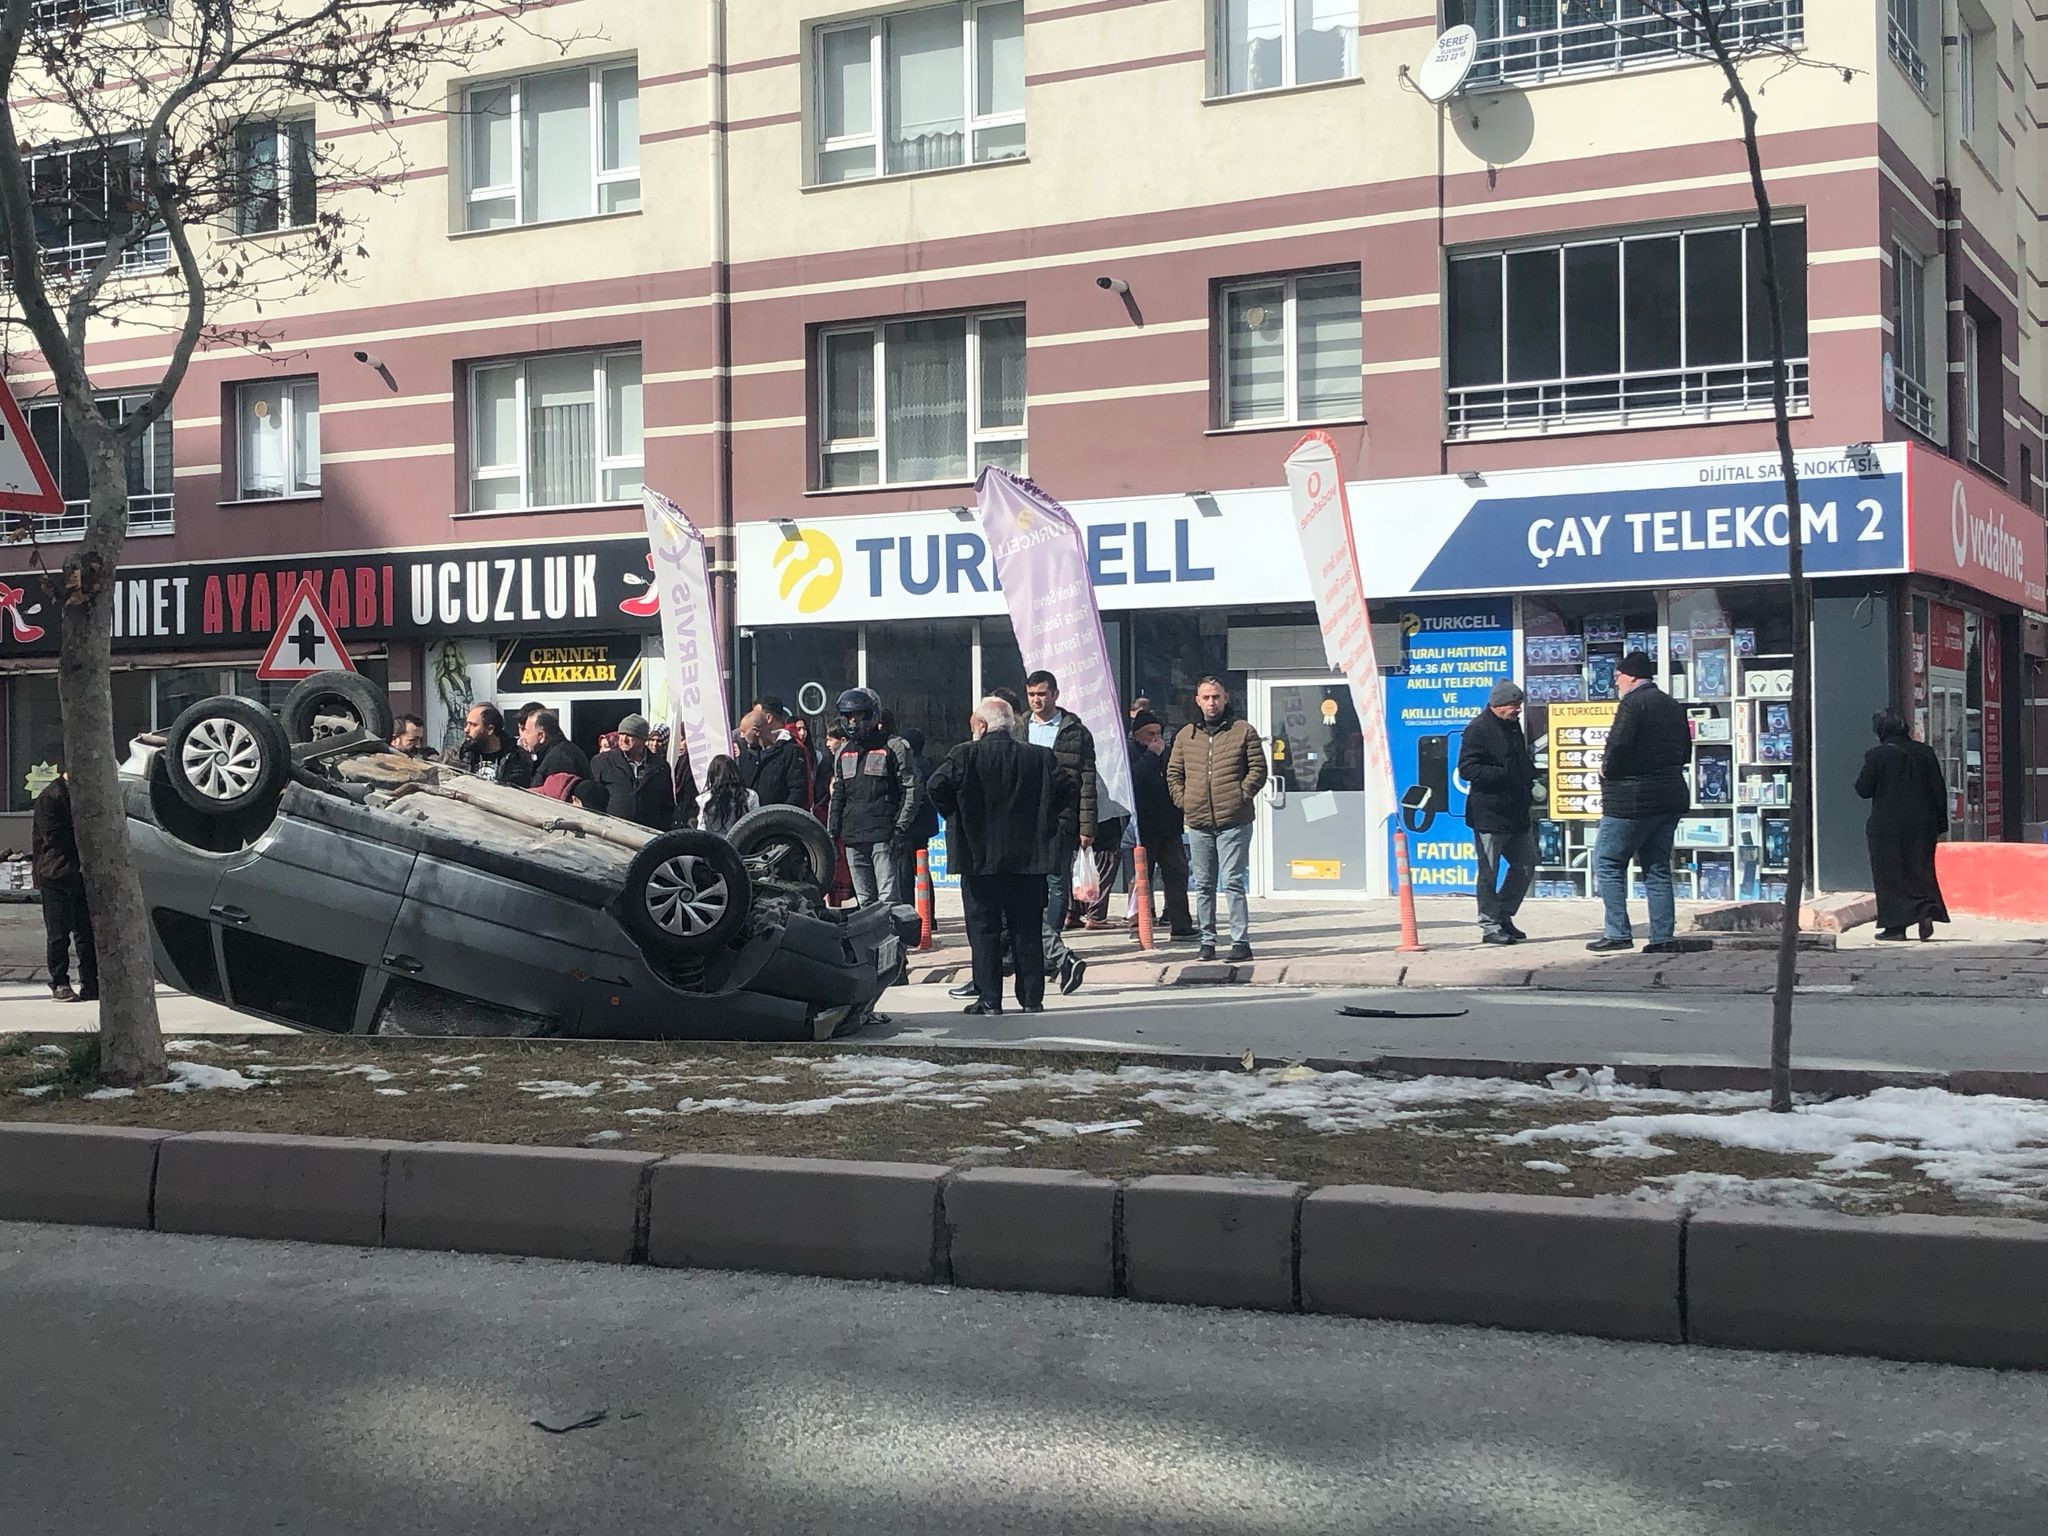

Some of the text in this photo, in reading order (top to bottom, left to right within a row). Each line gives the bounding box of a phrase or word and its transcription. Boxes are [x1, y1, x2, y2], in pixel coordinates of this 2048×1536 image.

[1439, 34, 1470, 50] ŞEREF
[1699, 464, 1754, 482] DİJİTAL
[1527, 498, 1884, 569] ÇAY TELEKOM 2
[1969, 507, 2024, 584] vodafone
[855, 519, 1215, 598] TURELL
[411, 553, 598, 626] UCUZLUK
[1423, 614, 1501, 630] TURKCELL
[530, 646, 609, 665] CENNET
[1446, 645, 1507, 658] HATTINIZA
[521, 665, 617, 684] AYAKKABI
[1440, 662, 1455, 674] AY
[1456, 659, 1508, 673] TAKSİTLE
[1407, 676, 1493, 690] AKILLI TELEFON
[1442, 692, 1458, 704] VE
[1409, 864, 1478, 886] TAHSİL
